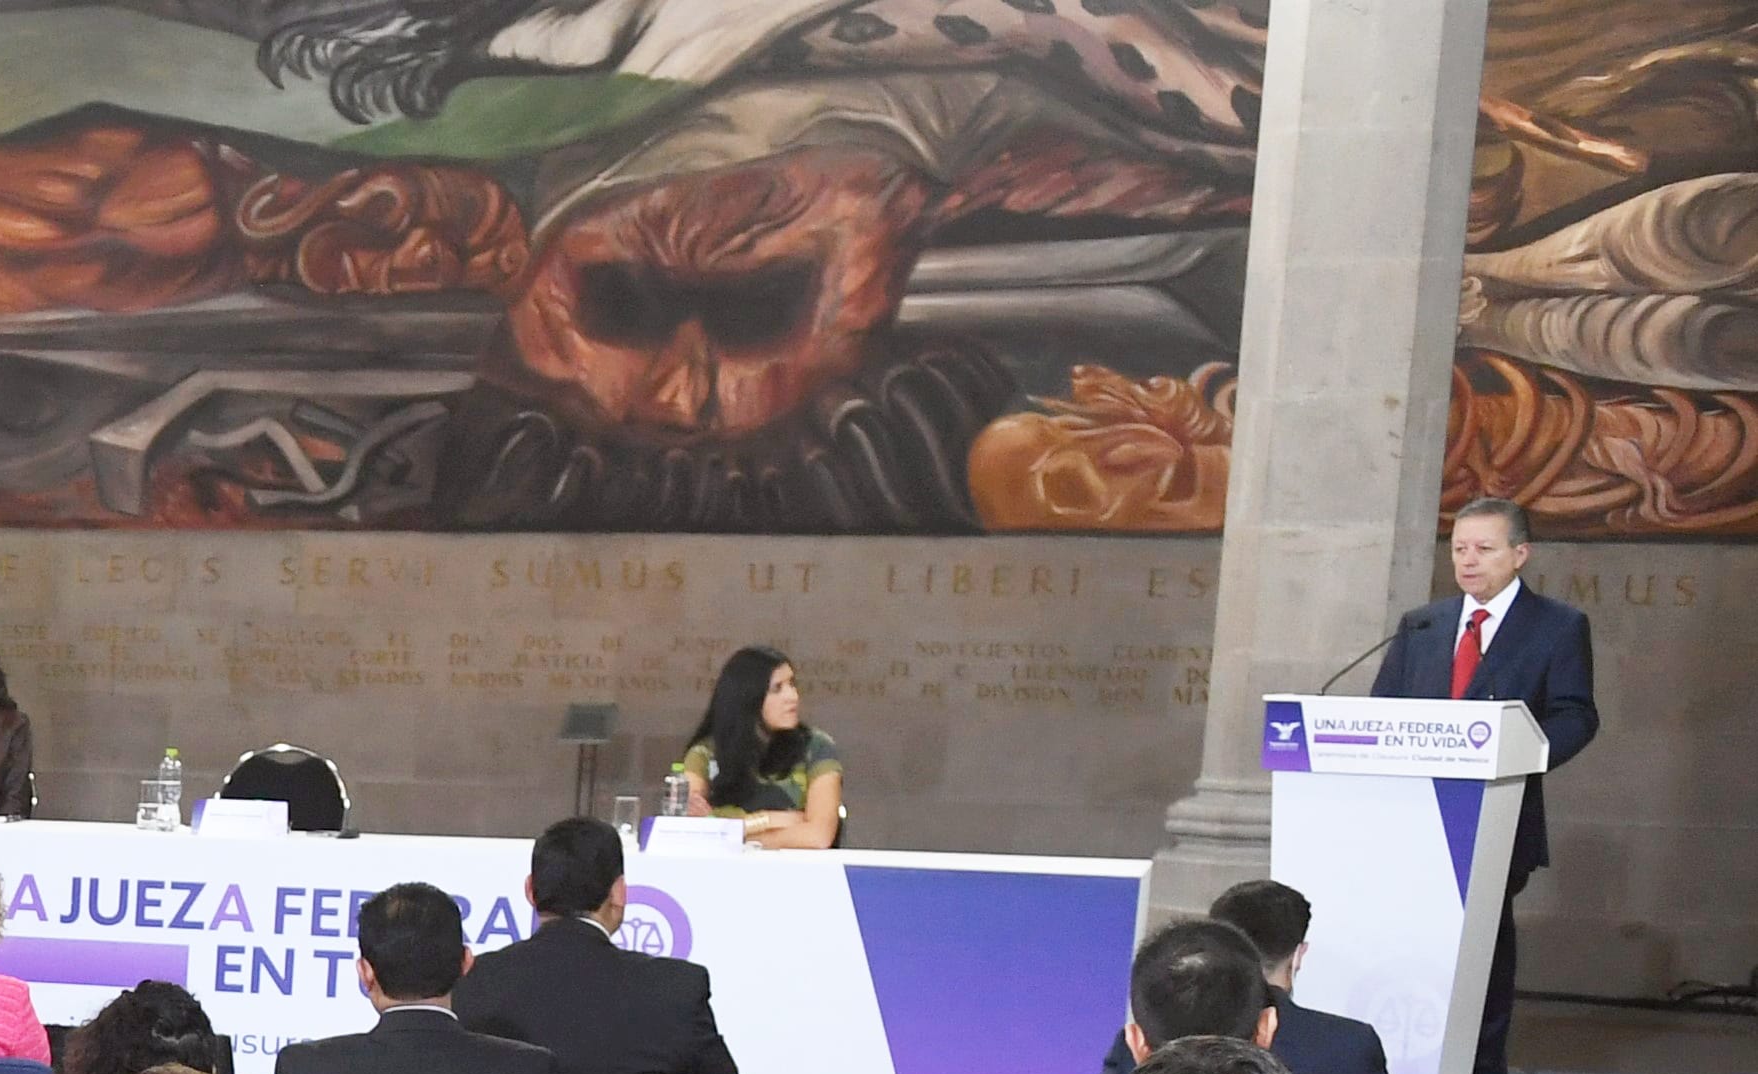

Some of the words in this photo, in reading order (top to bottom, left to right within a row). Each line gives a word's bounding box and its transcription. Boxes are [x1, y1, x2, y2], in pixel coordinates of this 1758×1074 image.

[279, 556, 435, 588] SERVI
[491, 559, 685, 591] SUMUS
[748, 562, 814, 593] UT
[887, 564, 1081, 596] LIBERI
[1148, 566, 1209, 598] ES
[1537, 574, 1697, 609] IMUS
[1314, 718, 1347, 731] UNA
[1348, 720, 1394, 733] JUEZA
[1398, 722, 1464, 736] FEDERAL
[1384, 735, 1403, 746] EN
[1410, 736, 1429, 748] TU
[1432, 736, 1468, 749] VIDA
[5, 873, 48, 922] A
[59, 876, 254, 933] JUEZA
[274, 886, 540, 944] FERA
[214, 945, 296, 996] EN
